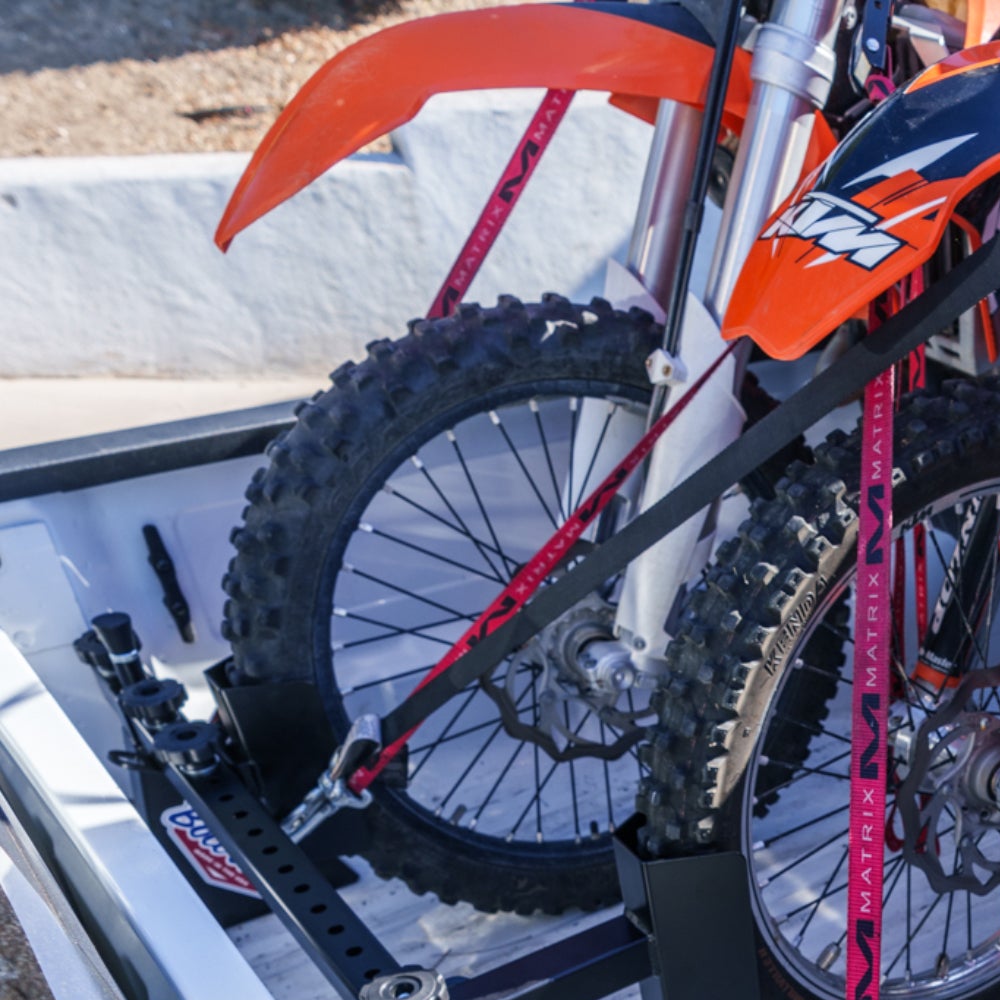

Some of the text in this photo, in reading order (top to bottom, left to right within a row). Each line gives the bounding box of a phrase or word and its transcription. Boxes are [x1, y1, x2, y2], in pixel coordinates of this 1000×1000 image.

[455, 205, 505, 286] MATRIX
[759, 190, 904, 271] KTM
[515, 522, 581, 596] MATRIX
[763, 575, 828, 677] KENDA
[865, 572, 881, 688] MATRIX
[858, 788, 875, 913] MATRIX
